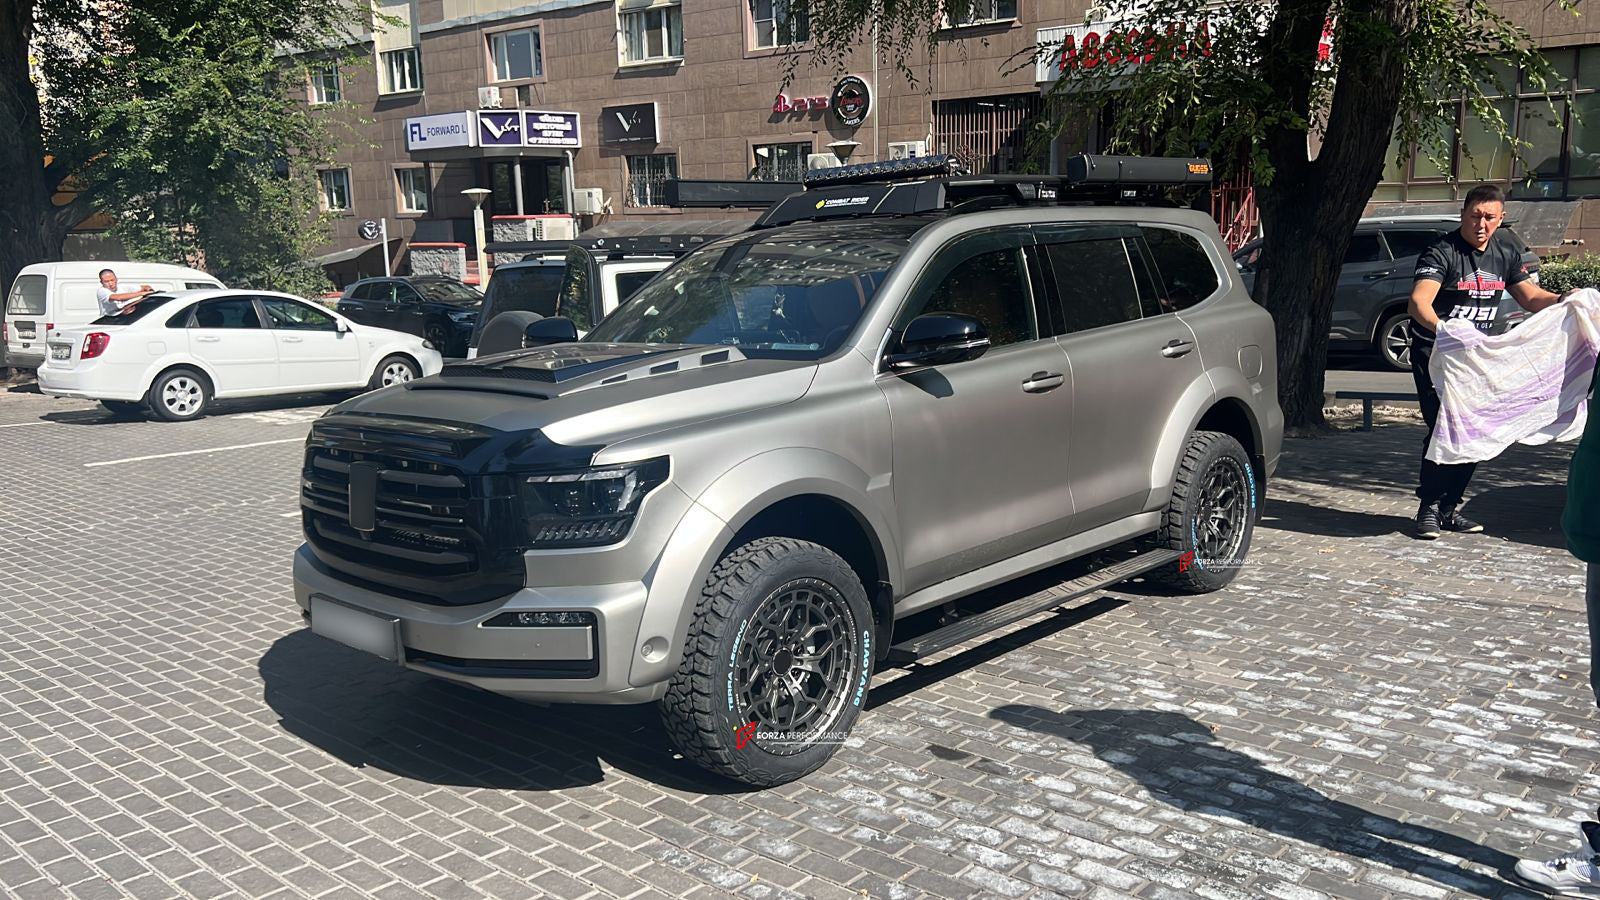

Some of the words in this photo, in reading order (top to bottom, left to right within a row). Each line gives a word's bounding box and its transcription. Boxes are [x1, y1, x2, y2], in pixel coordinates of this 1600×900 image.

[427, 125, 460, 137] FORWARD
[729, 619, 747, 668] LEGEND
[852, 630, 870, 706] CHAOYANG
